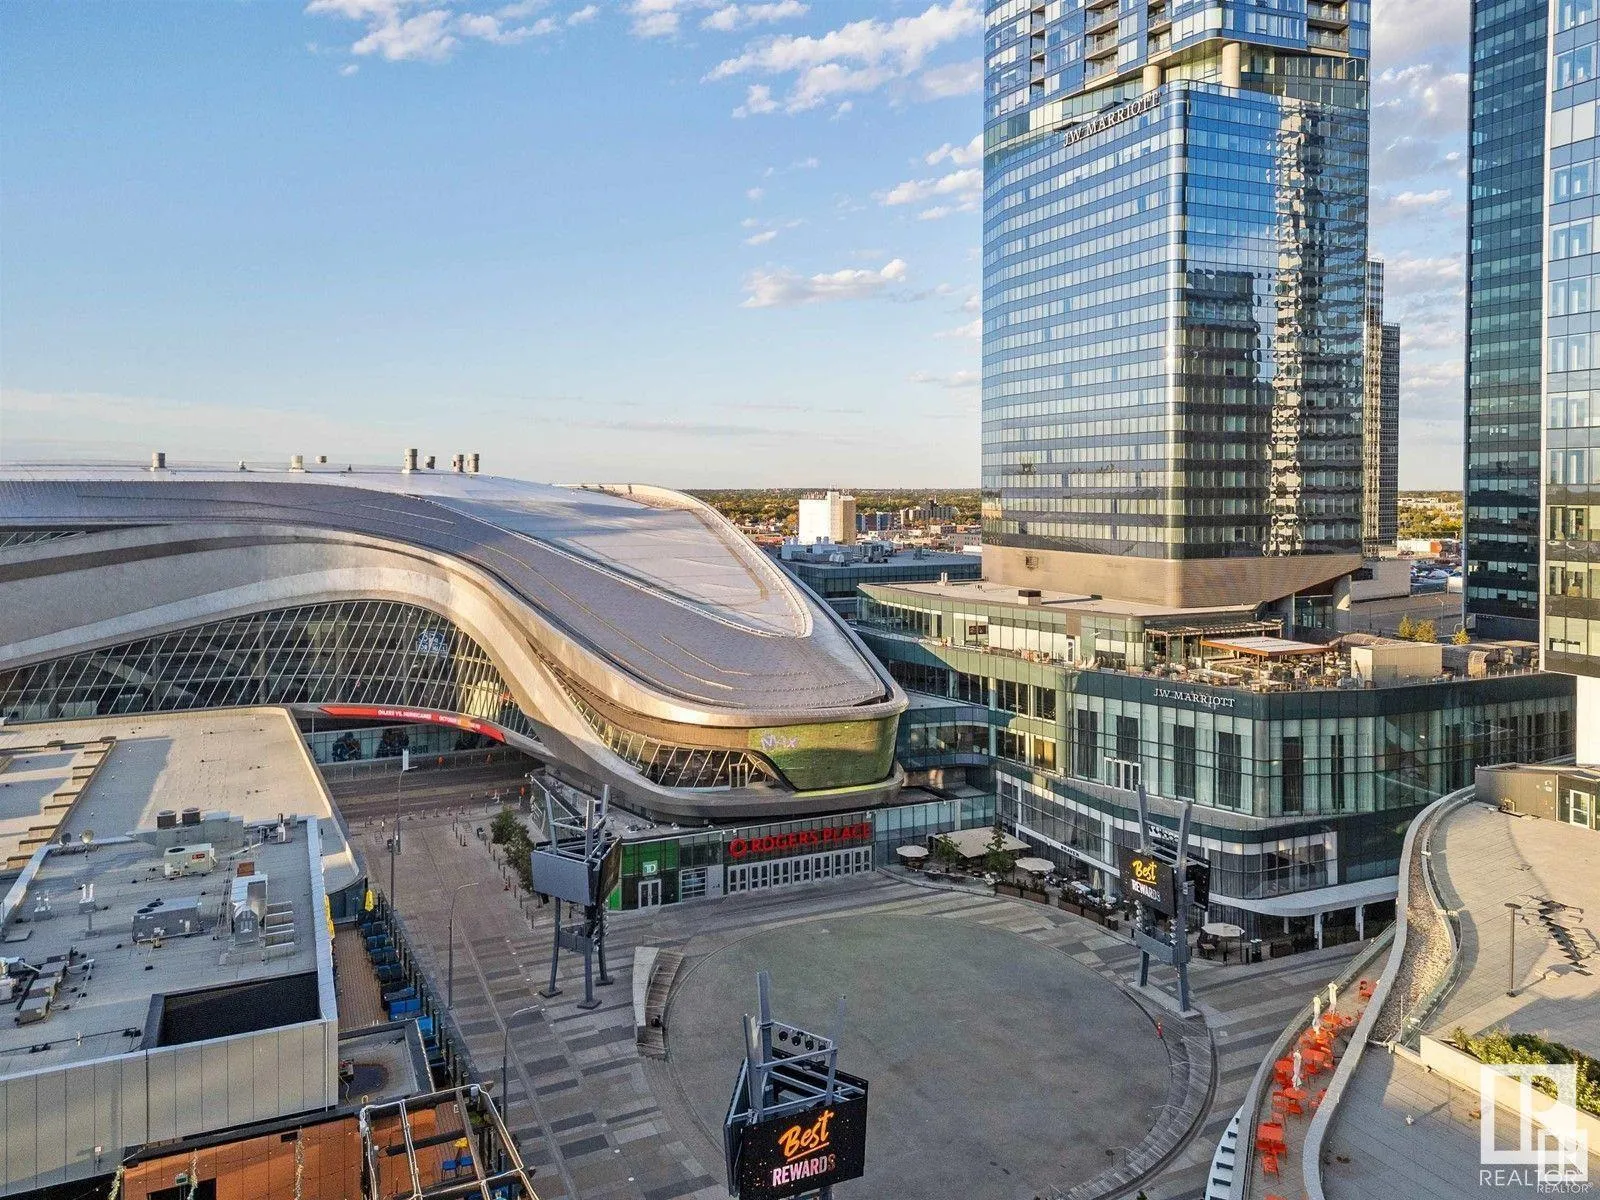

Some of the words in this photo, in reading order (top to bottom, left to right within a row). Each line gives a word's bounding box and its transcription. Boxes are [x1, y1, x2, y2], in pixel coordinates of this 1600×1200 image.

[1063, 127, 1084, 147] JW
[1086, 91, 1160, 135] MARRIOTT
[1153, 688, 1171, 698] JW
[1174, 691, 1235, 708] MARRIOTT
[751, 830, 818, 853] ROGERS
[823, 822, 872, 843] PLACE
[643, 864, 657, 874] TD
[1132, 860, 1157, 880] Best
[778, 1109, 834, 1157] Best
[772, 1153, 836, 1187] REWARDS
